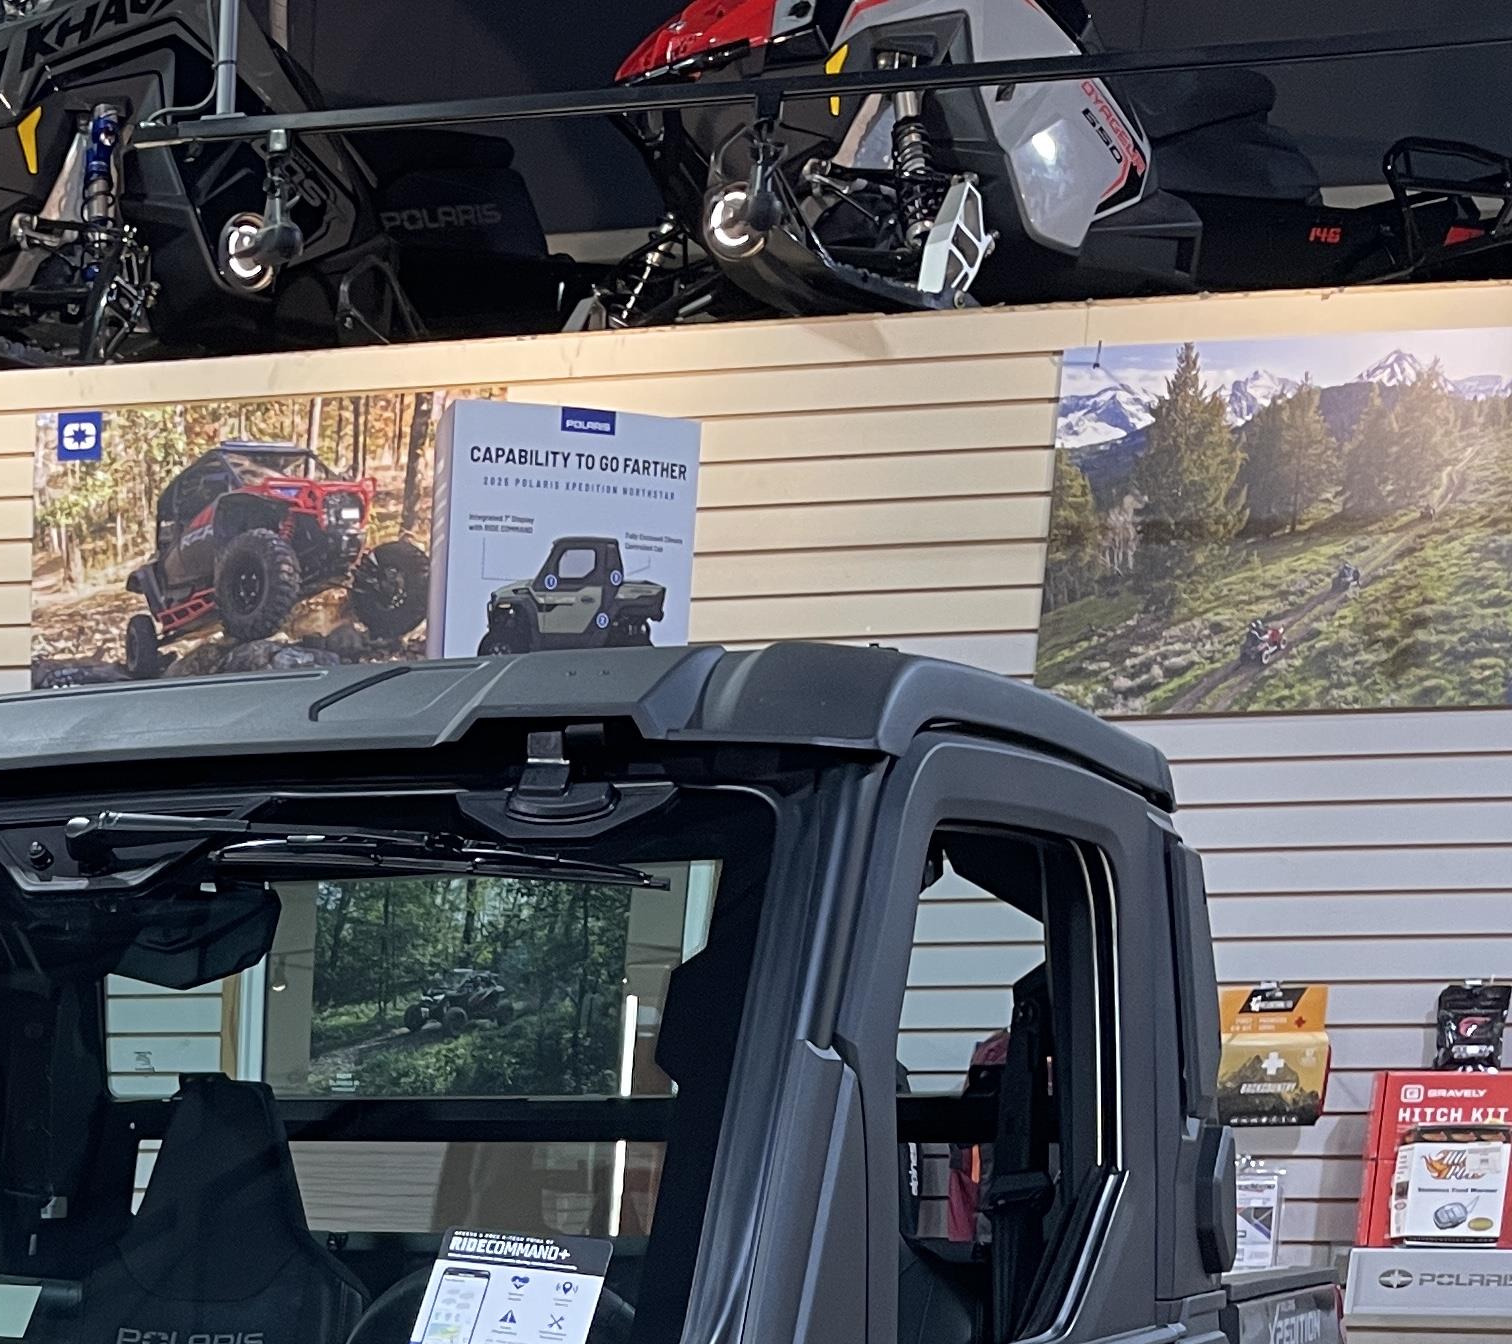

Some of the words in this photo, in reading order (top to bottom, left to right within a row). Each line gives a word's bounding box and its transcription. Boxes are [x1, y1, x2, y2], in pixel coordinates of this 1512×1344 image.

[380, 203, 503, 231] POLARIS
[1308, 226, 1342, 243] 146
[565, 418, 611, 432] POLARIS
[470, 445, 571, 469] CAPABILITY
[575, 453, 596, 471] TO
[599, 455, 619, 473] GO
[623, 457, 687, 481] FARTHER
[514, 478, 560, 491] POLARIS
[1427, 1088, 1487, 1098] GRAVELY
[1397, 1107, 1464, 1123] HITCH
[1470, 1107, 1510, 1123] KIT
[448, 1236, 571, 1261] RIDECOMMAND+
